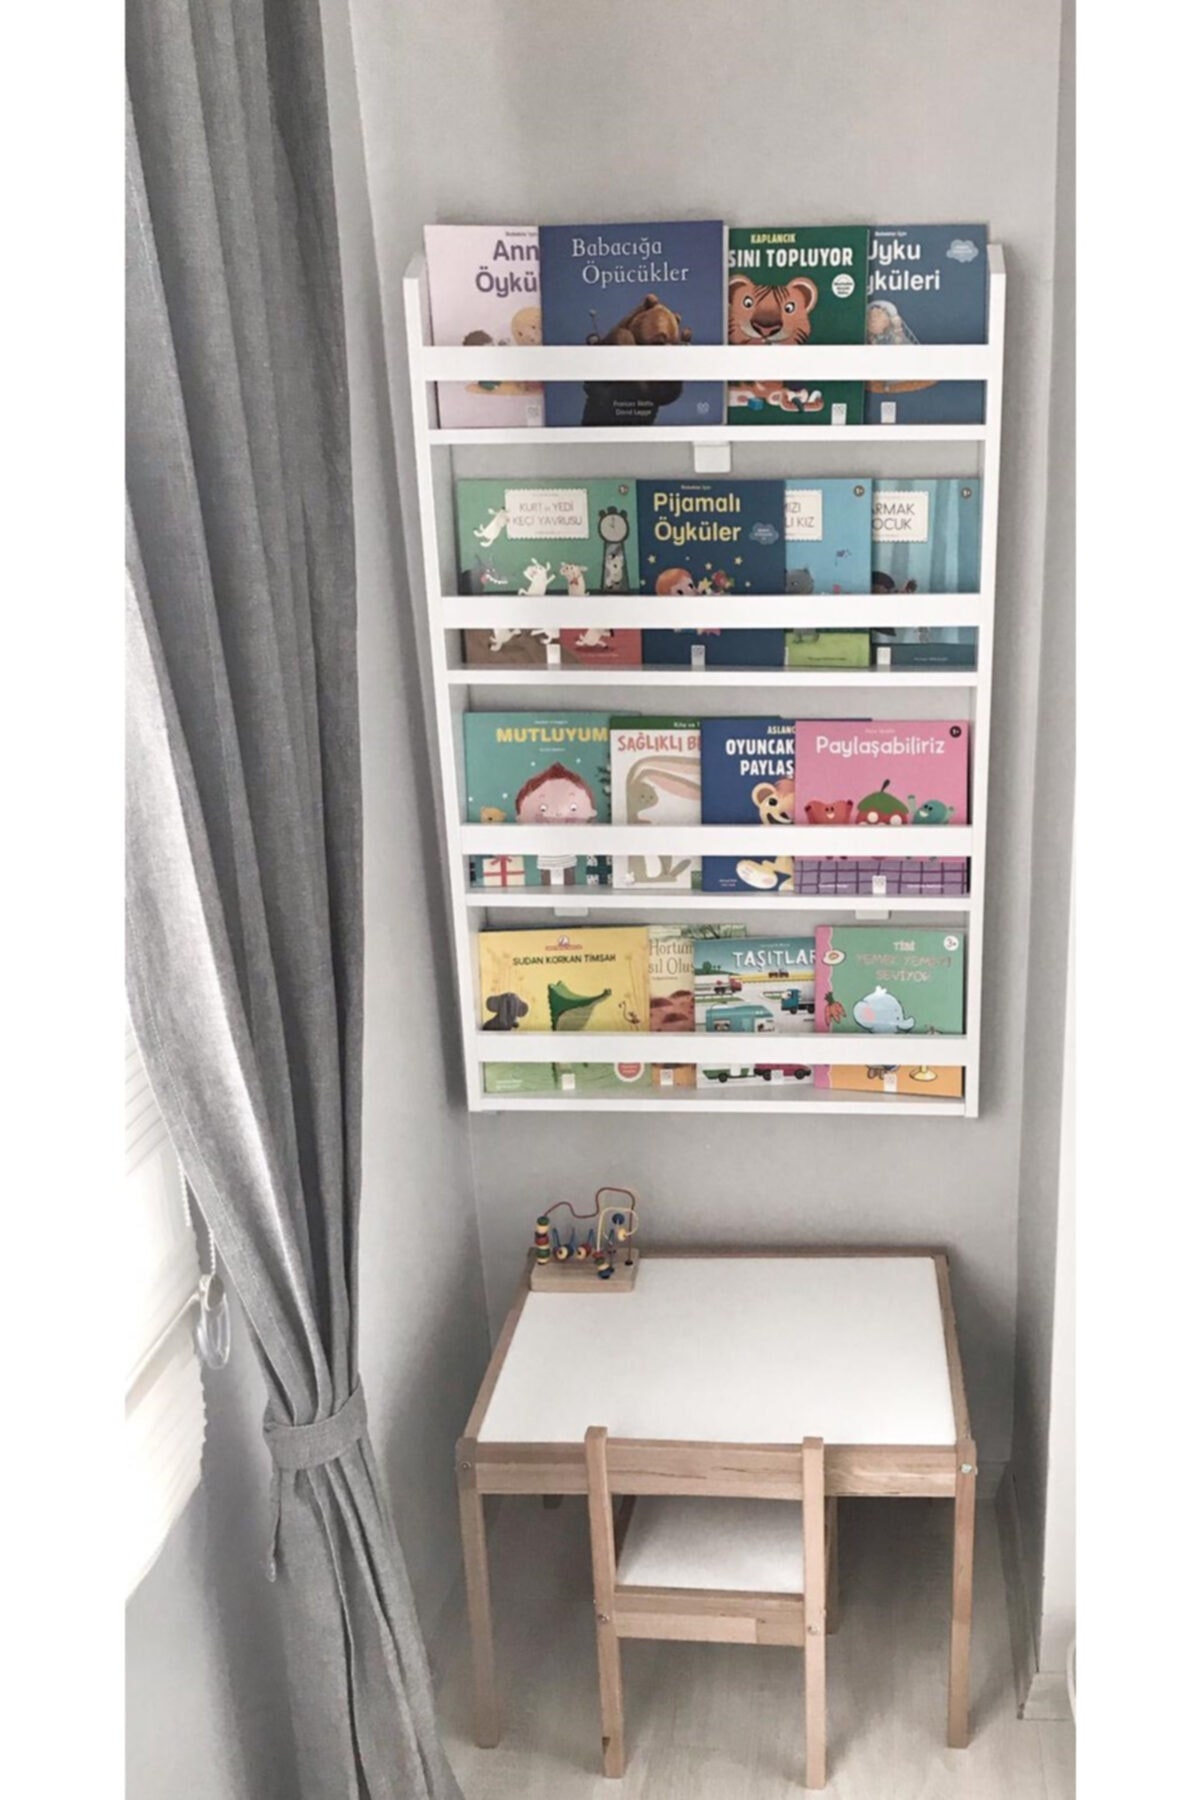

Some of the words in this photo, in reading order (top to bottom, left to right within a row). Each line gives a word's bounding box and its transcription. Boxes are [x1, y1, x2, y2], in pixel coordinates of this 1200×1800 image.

[571, 236, 663, 260] Babacığa
[728, 249, 760, 268] SINI
[766, 248, 854, 268] TOPLUYOR
[476, 265, 538, 298] Öykü
[582, 260, 689, 289] Öpücükler
[653, 493, 741, 517] Pijamalı
[654, 516, 742, 546] Öyküler
[496, 727, 608, 743] MUTLUYUM
[617, 732, 682, 752] SAĞLIKLI
[726, 739, 795, 755] OYUNCAK
[816, 736, 945, 758] Paylaşabiliriz
[740, 760, 794, 778] PAYLAŞ
[513, 956, 544, 966] SUDAN
[545, 955, 582, 965] KORKAN
